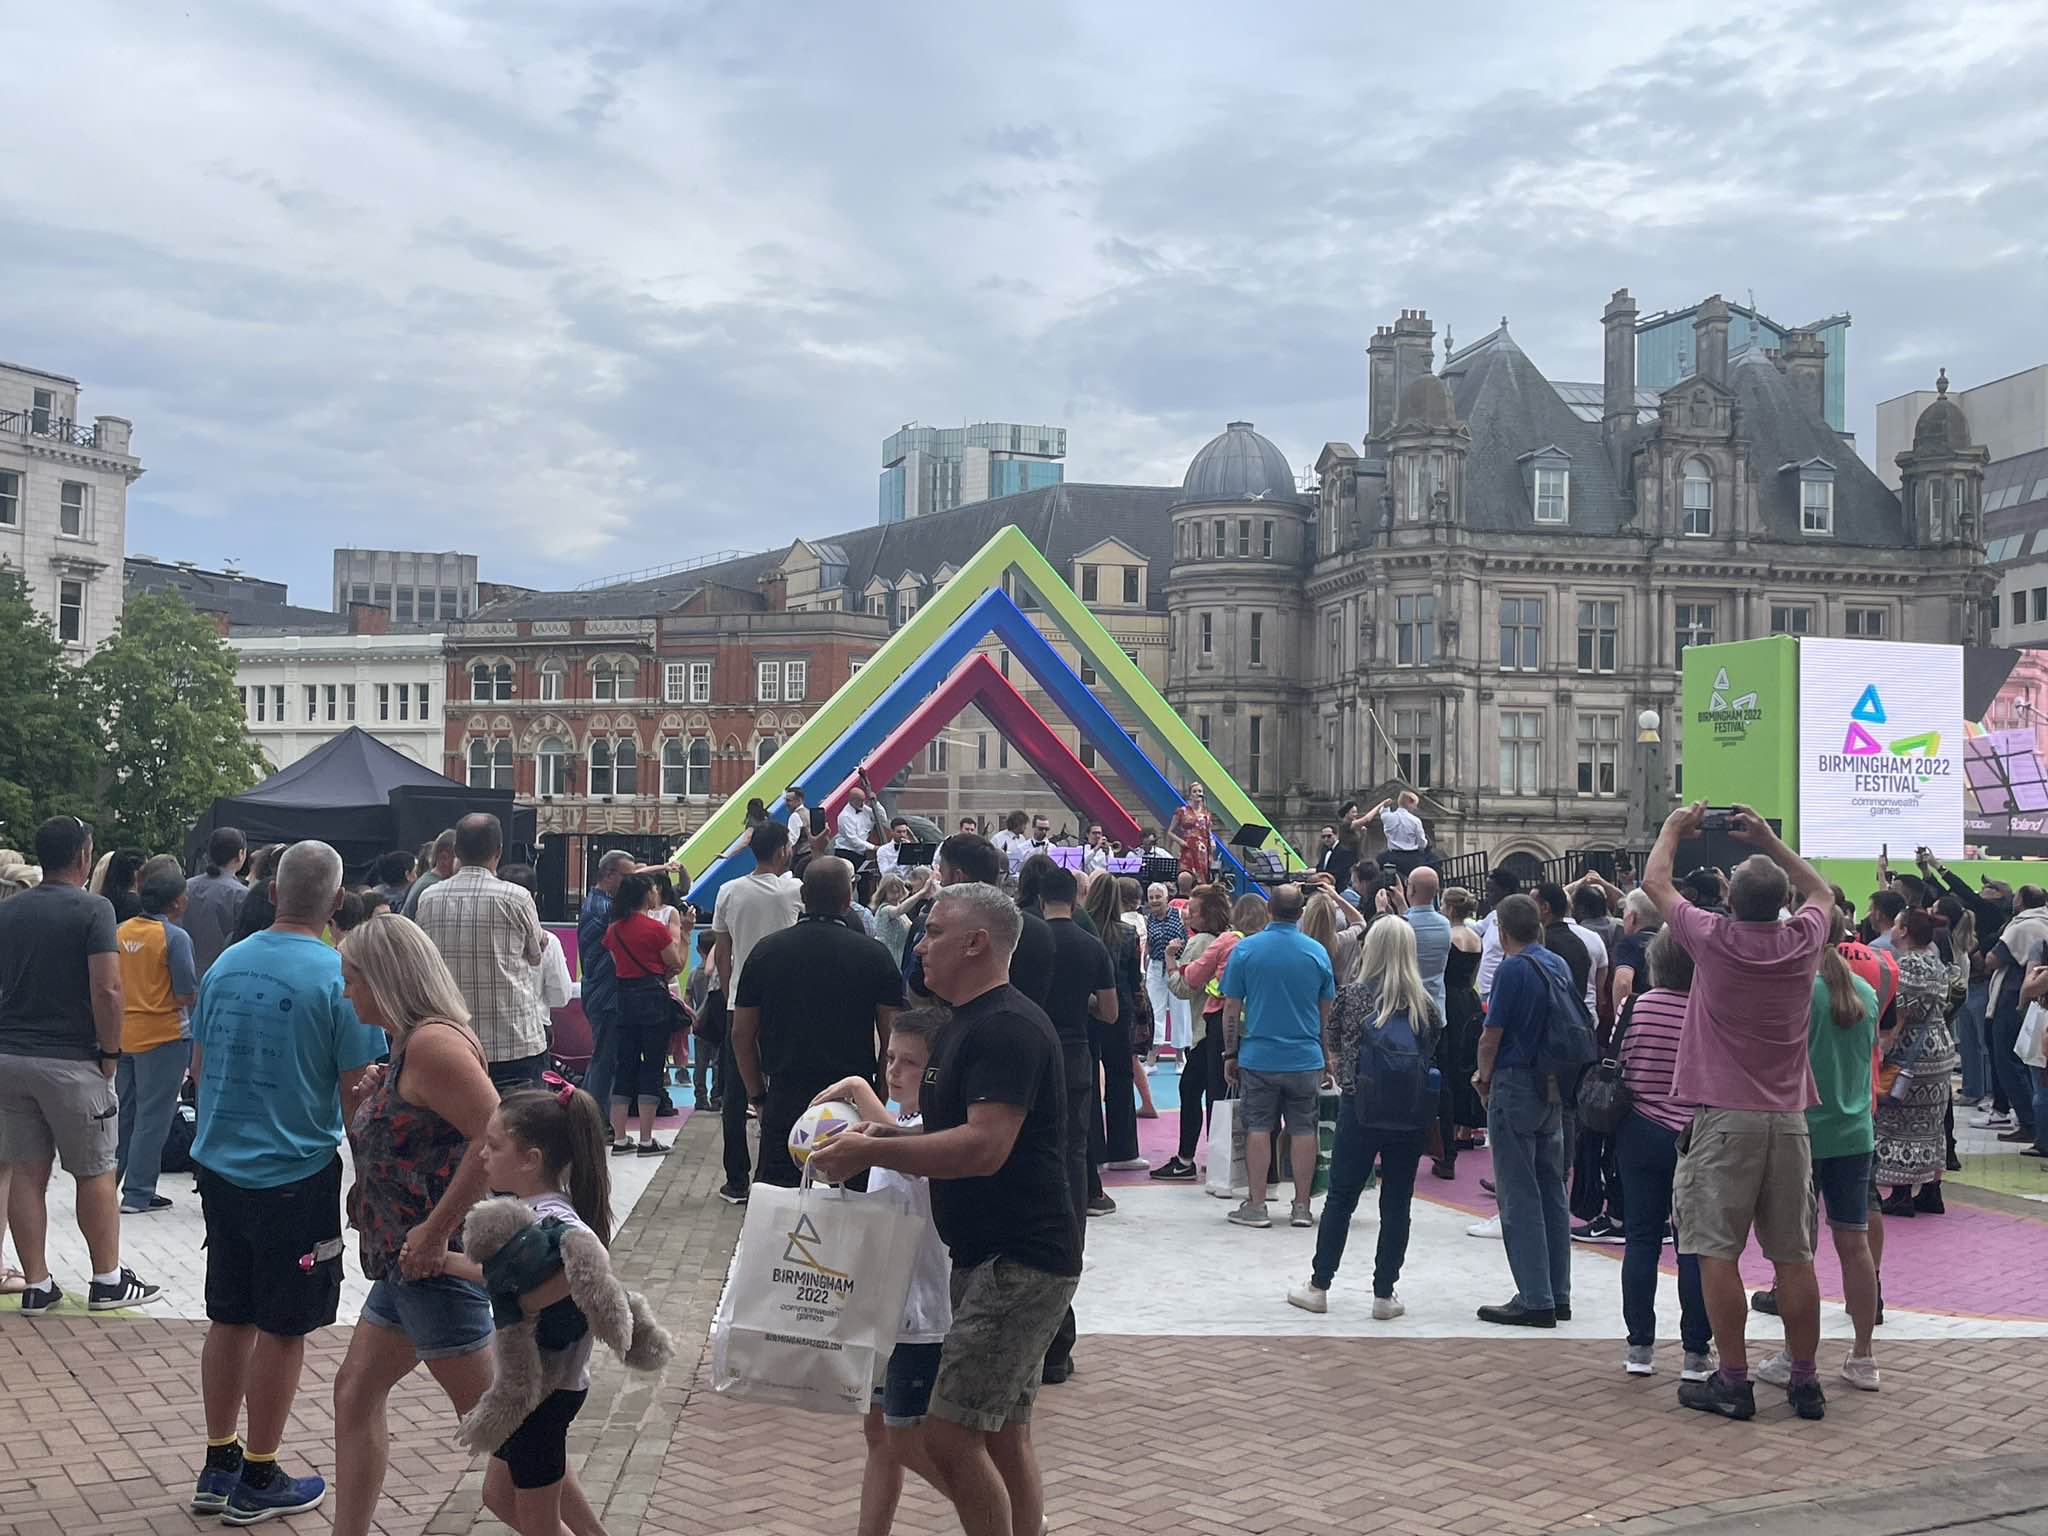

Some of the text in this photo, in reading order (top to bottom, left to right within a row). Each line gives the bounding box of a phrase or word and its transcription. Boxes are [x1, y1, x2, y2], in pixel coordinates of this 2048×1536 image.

[1698, 708, 1761, 722] BIRMINGHAM 2022
[1714, 721, 1745, 732] FESTIVAL
[1819, 755, 1950, 776] BIRMINGHAM 2022
[1855, 775, 1919, 793] FESTIVAL
[1851, 797, 1919, 807] commonwealth
[1870, 806, 1901, 817] games
[2007, 817, 2043, 832] Roland
[772, 1268, 855, 1293] BIRMINGHAM
[796, 1286, 829, 1304] 2022
